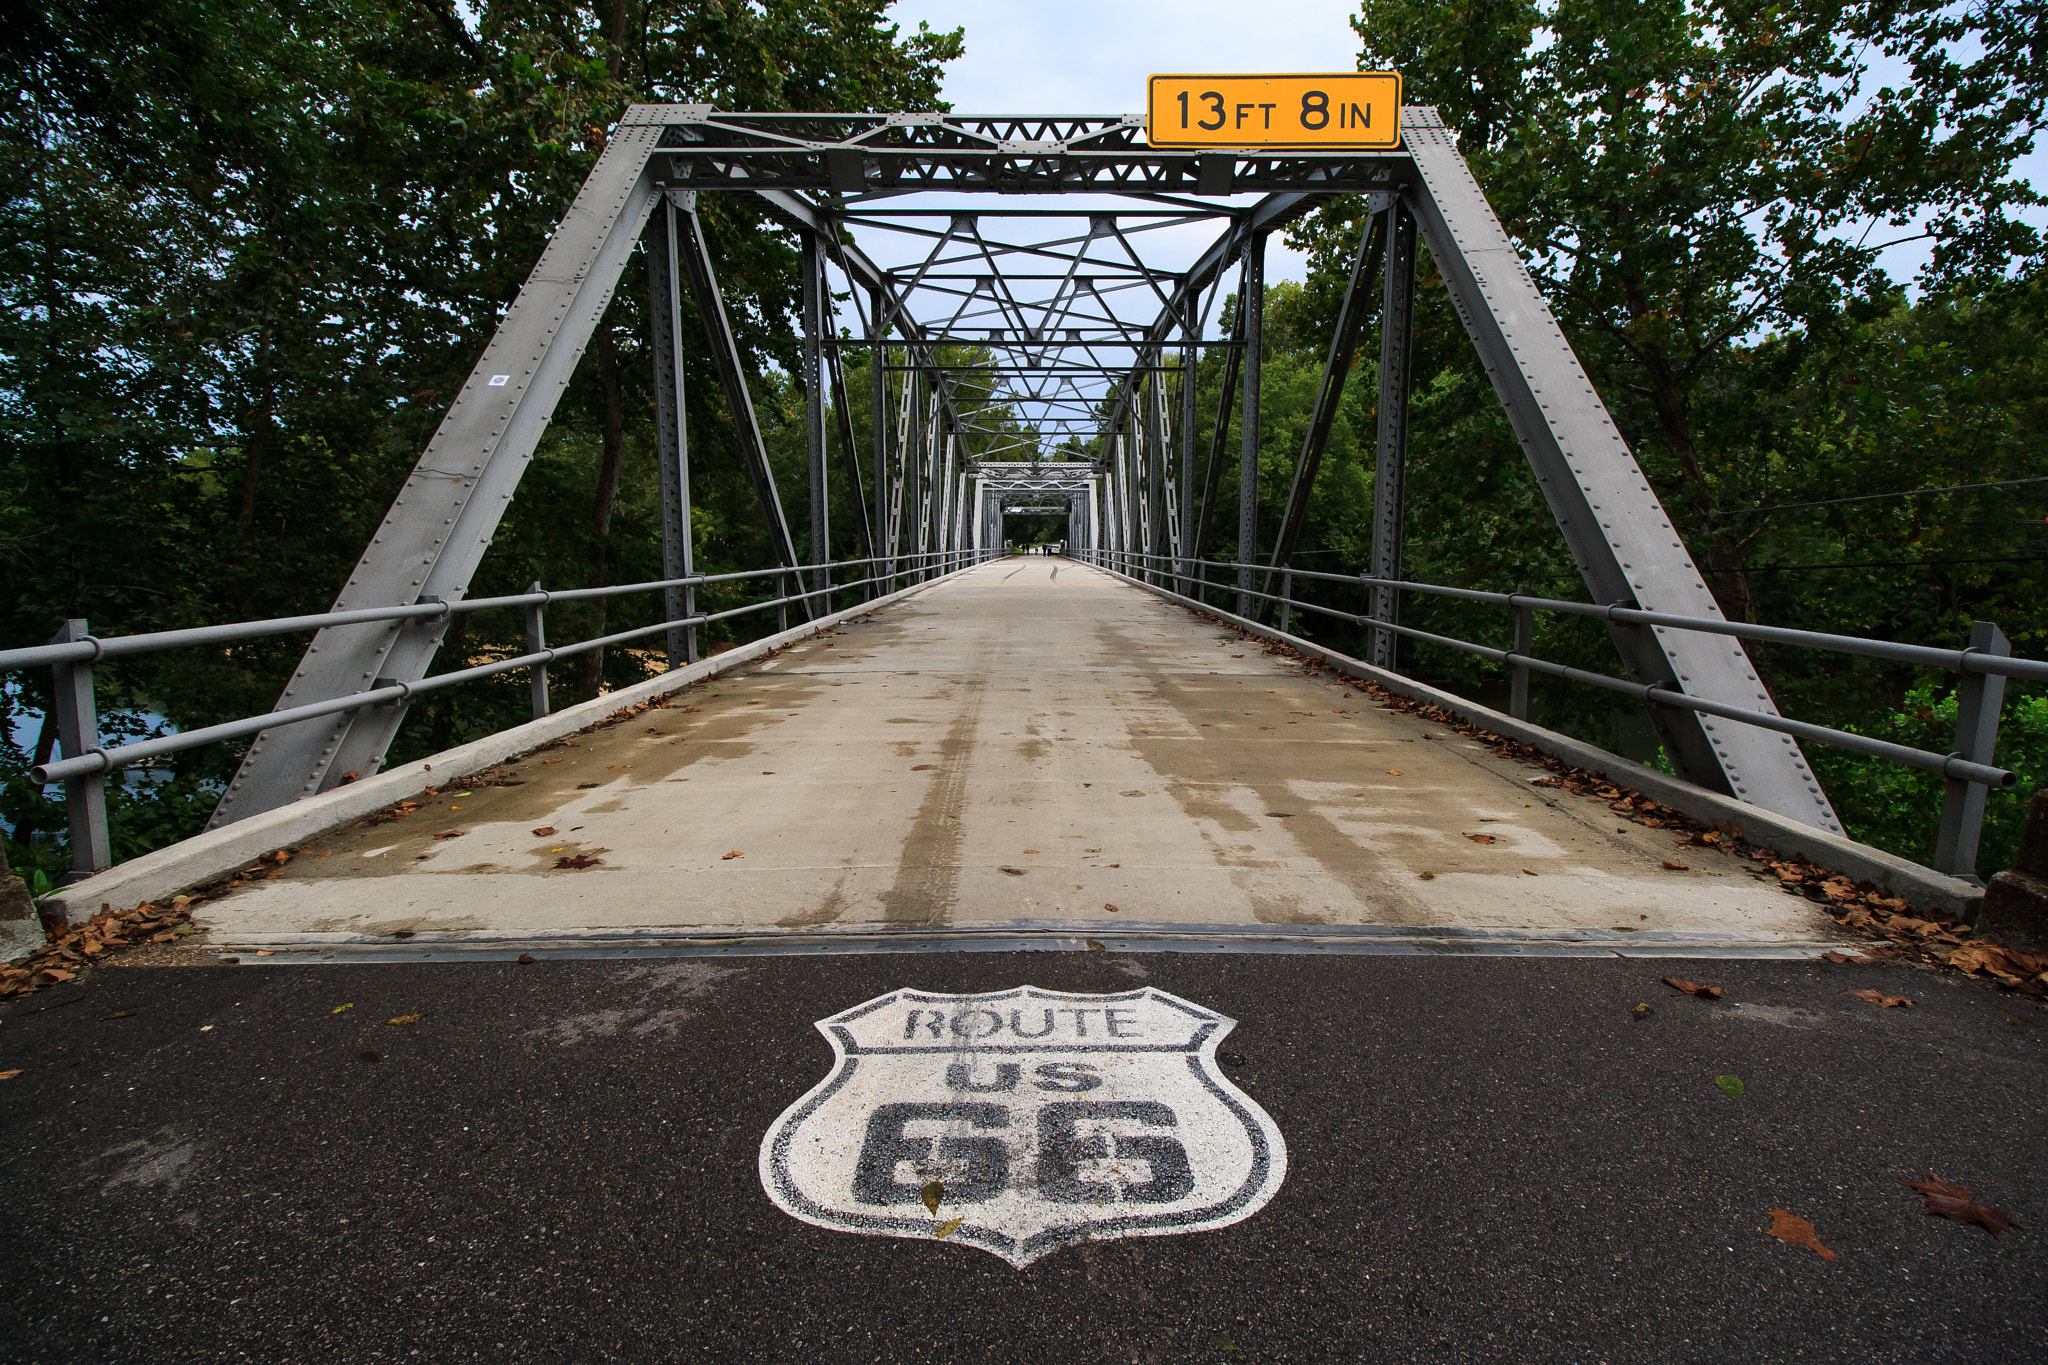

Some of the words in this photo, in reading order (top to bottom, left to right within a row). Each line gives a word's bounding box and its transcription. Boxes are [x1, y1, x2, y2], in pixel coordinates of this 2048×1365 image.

[903, 1008, 1145, 1040] ROUTE
[945, 1062, 1104, 1093] US
[849, 1100, 1196, 1205] 66
